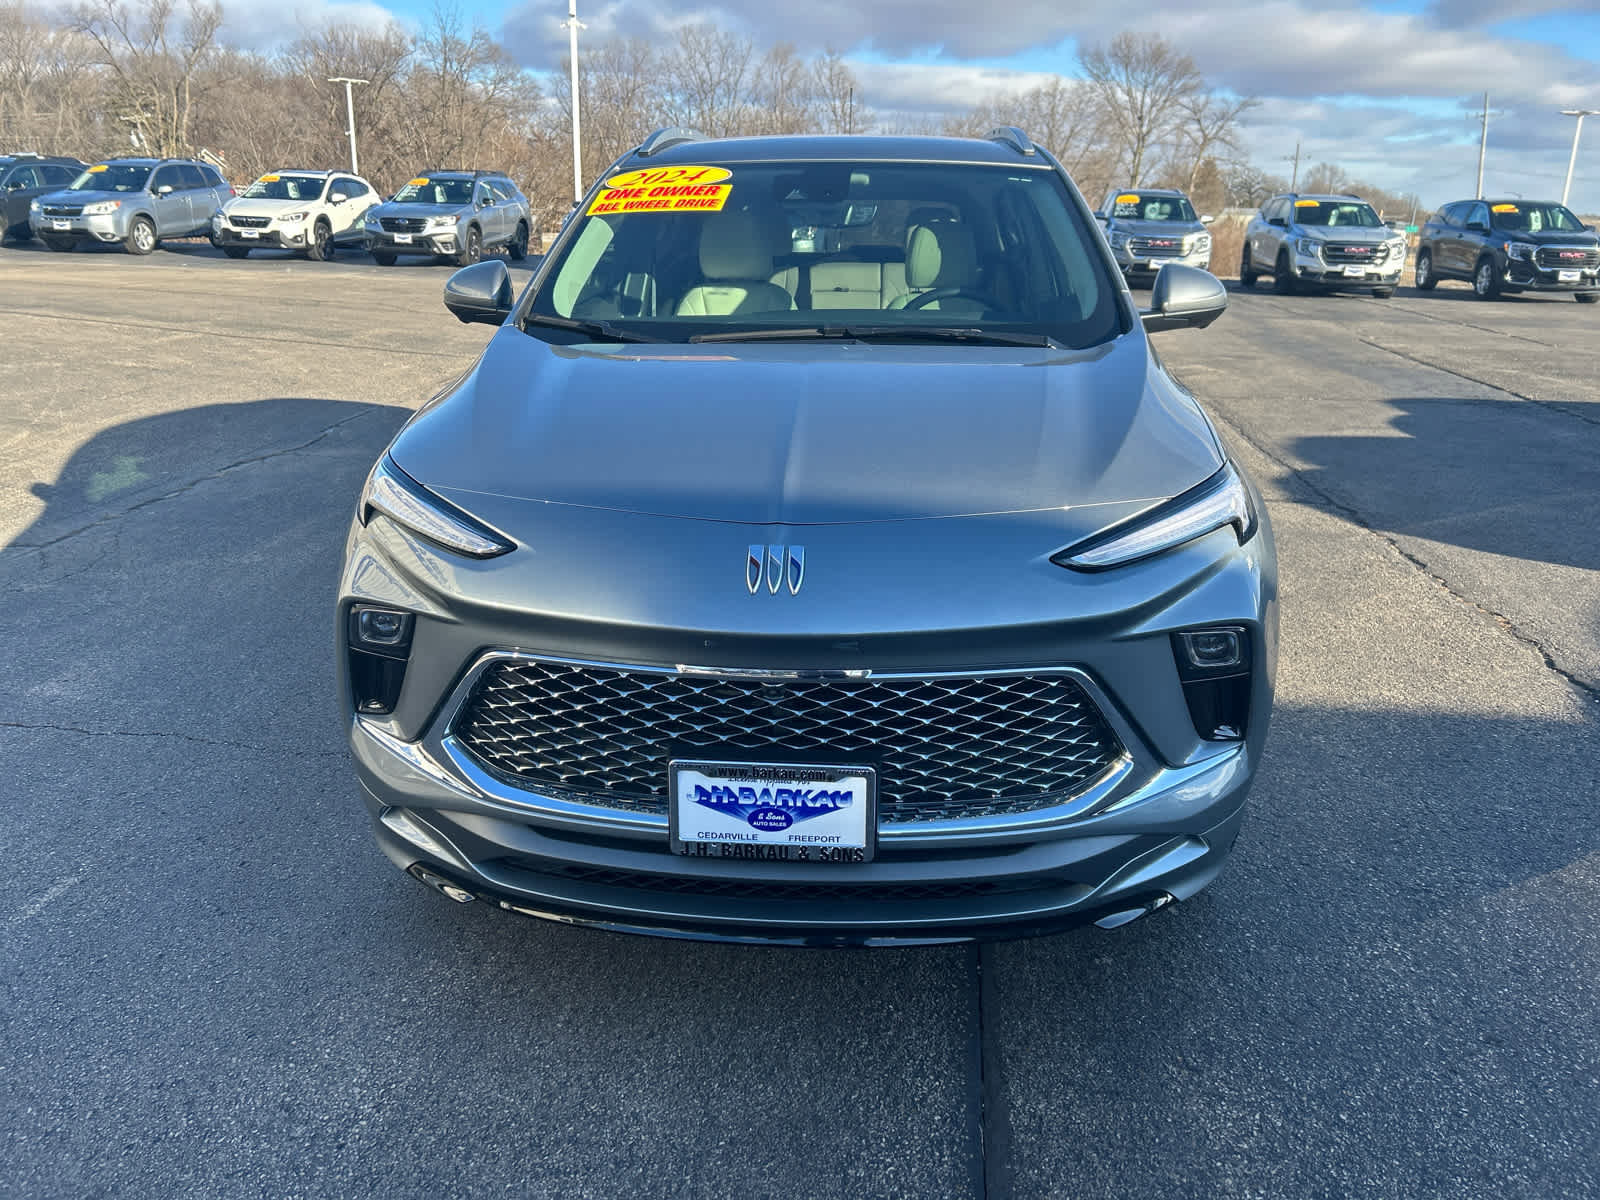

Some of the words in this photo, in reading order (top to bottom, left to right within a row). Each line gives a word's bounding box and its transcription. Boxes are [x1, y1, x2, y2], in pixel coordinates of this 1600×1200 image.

[620, 169, 710, 186] 2024
[604, 188, 648, 201] ONE
[648, 186, 721, 197] OWNER
[592, 203, 620, 214] ALL
[622, 200, 671, 210] WHEEL
[673, 198, 720, 208] DRIVE
[717, 766, 827, 781] www.barkau.com
[697, 831, 759, 841] CEDARVILLE
[788, 834, 841, 844] FREEPORT
[680, 842, 714, 857] J.H.
[721, 843, 789, 861] BARKAU
[819, 846, 865, 863] SONS
